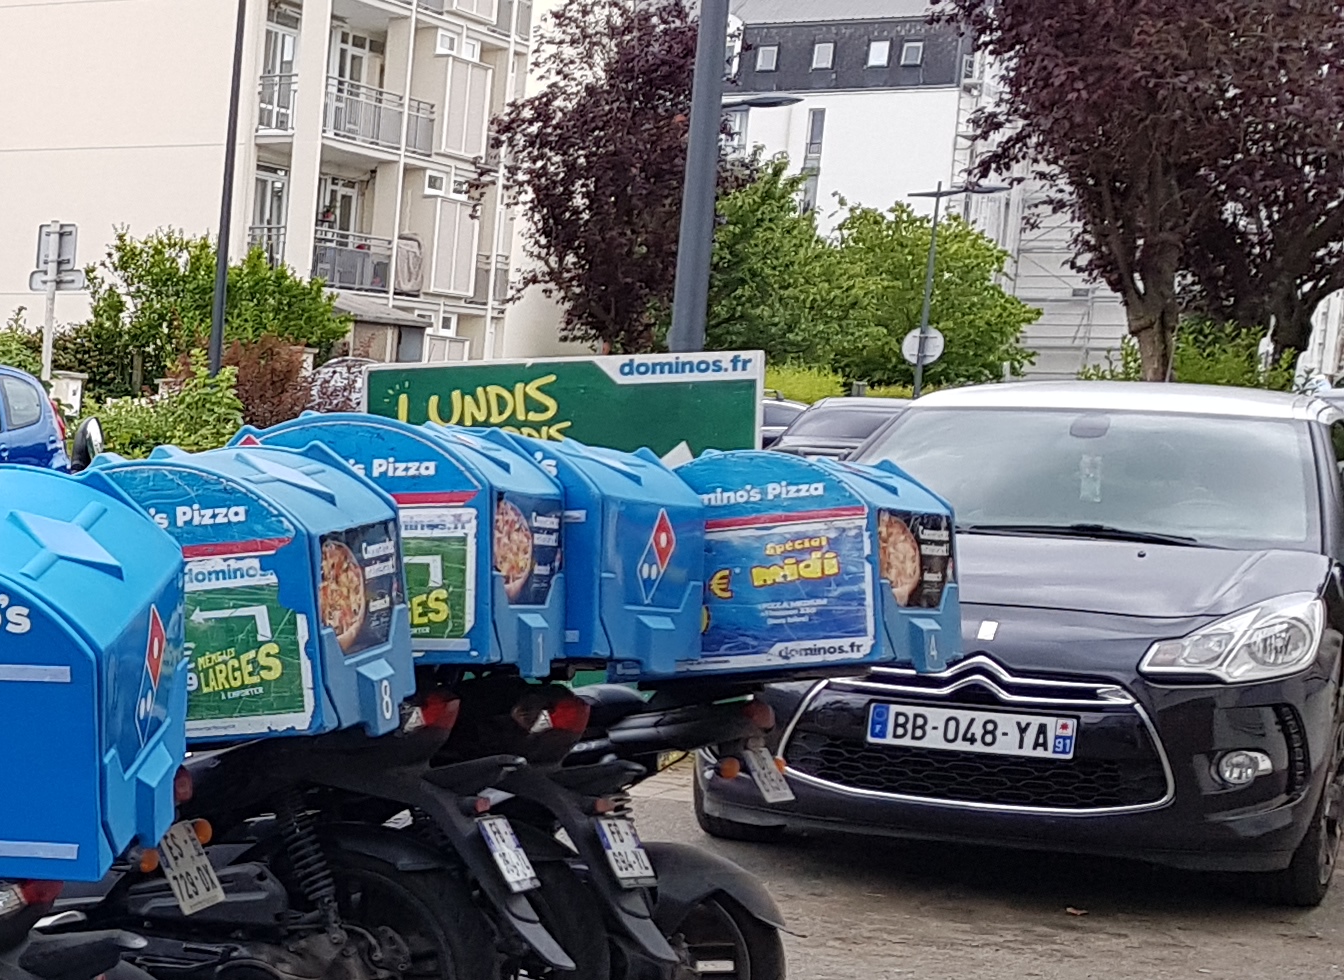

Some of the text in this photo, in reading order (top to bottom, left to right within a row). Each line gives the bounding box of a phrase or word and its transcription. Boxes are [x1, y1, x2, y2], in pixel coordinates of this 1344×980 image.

[619, 354, 752, 377] dominos.fr
[373, 457, 436, 477] Pizza
[767, 481, 824, 500] Pizza
[176, 504, 246, 527] Pizza
[752, 551, 839, 587] midi
[199, 642, 282, 693] LARGES
[381, 679, 393, 720] 8
[892, 711, 1049, 752] BB-048-YA
